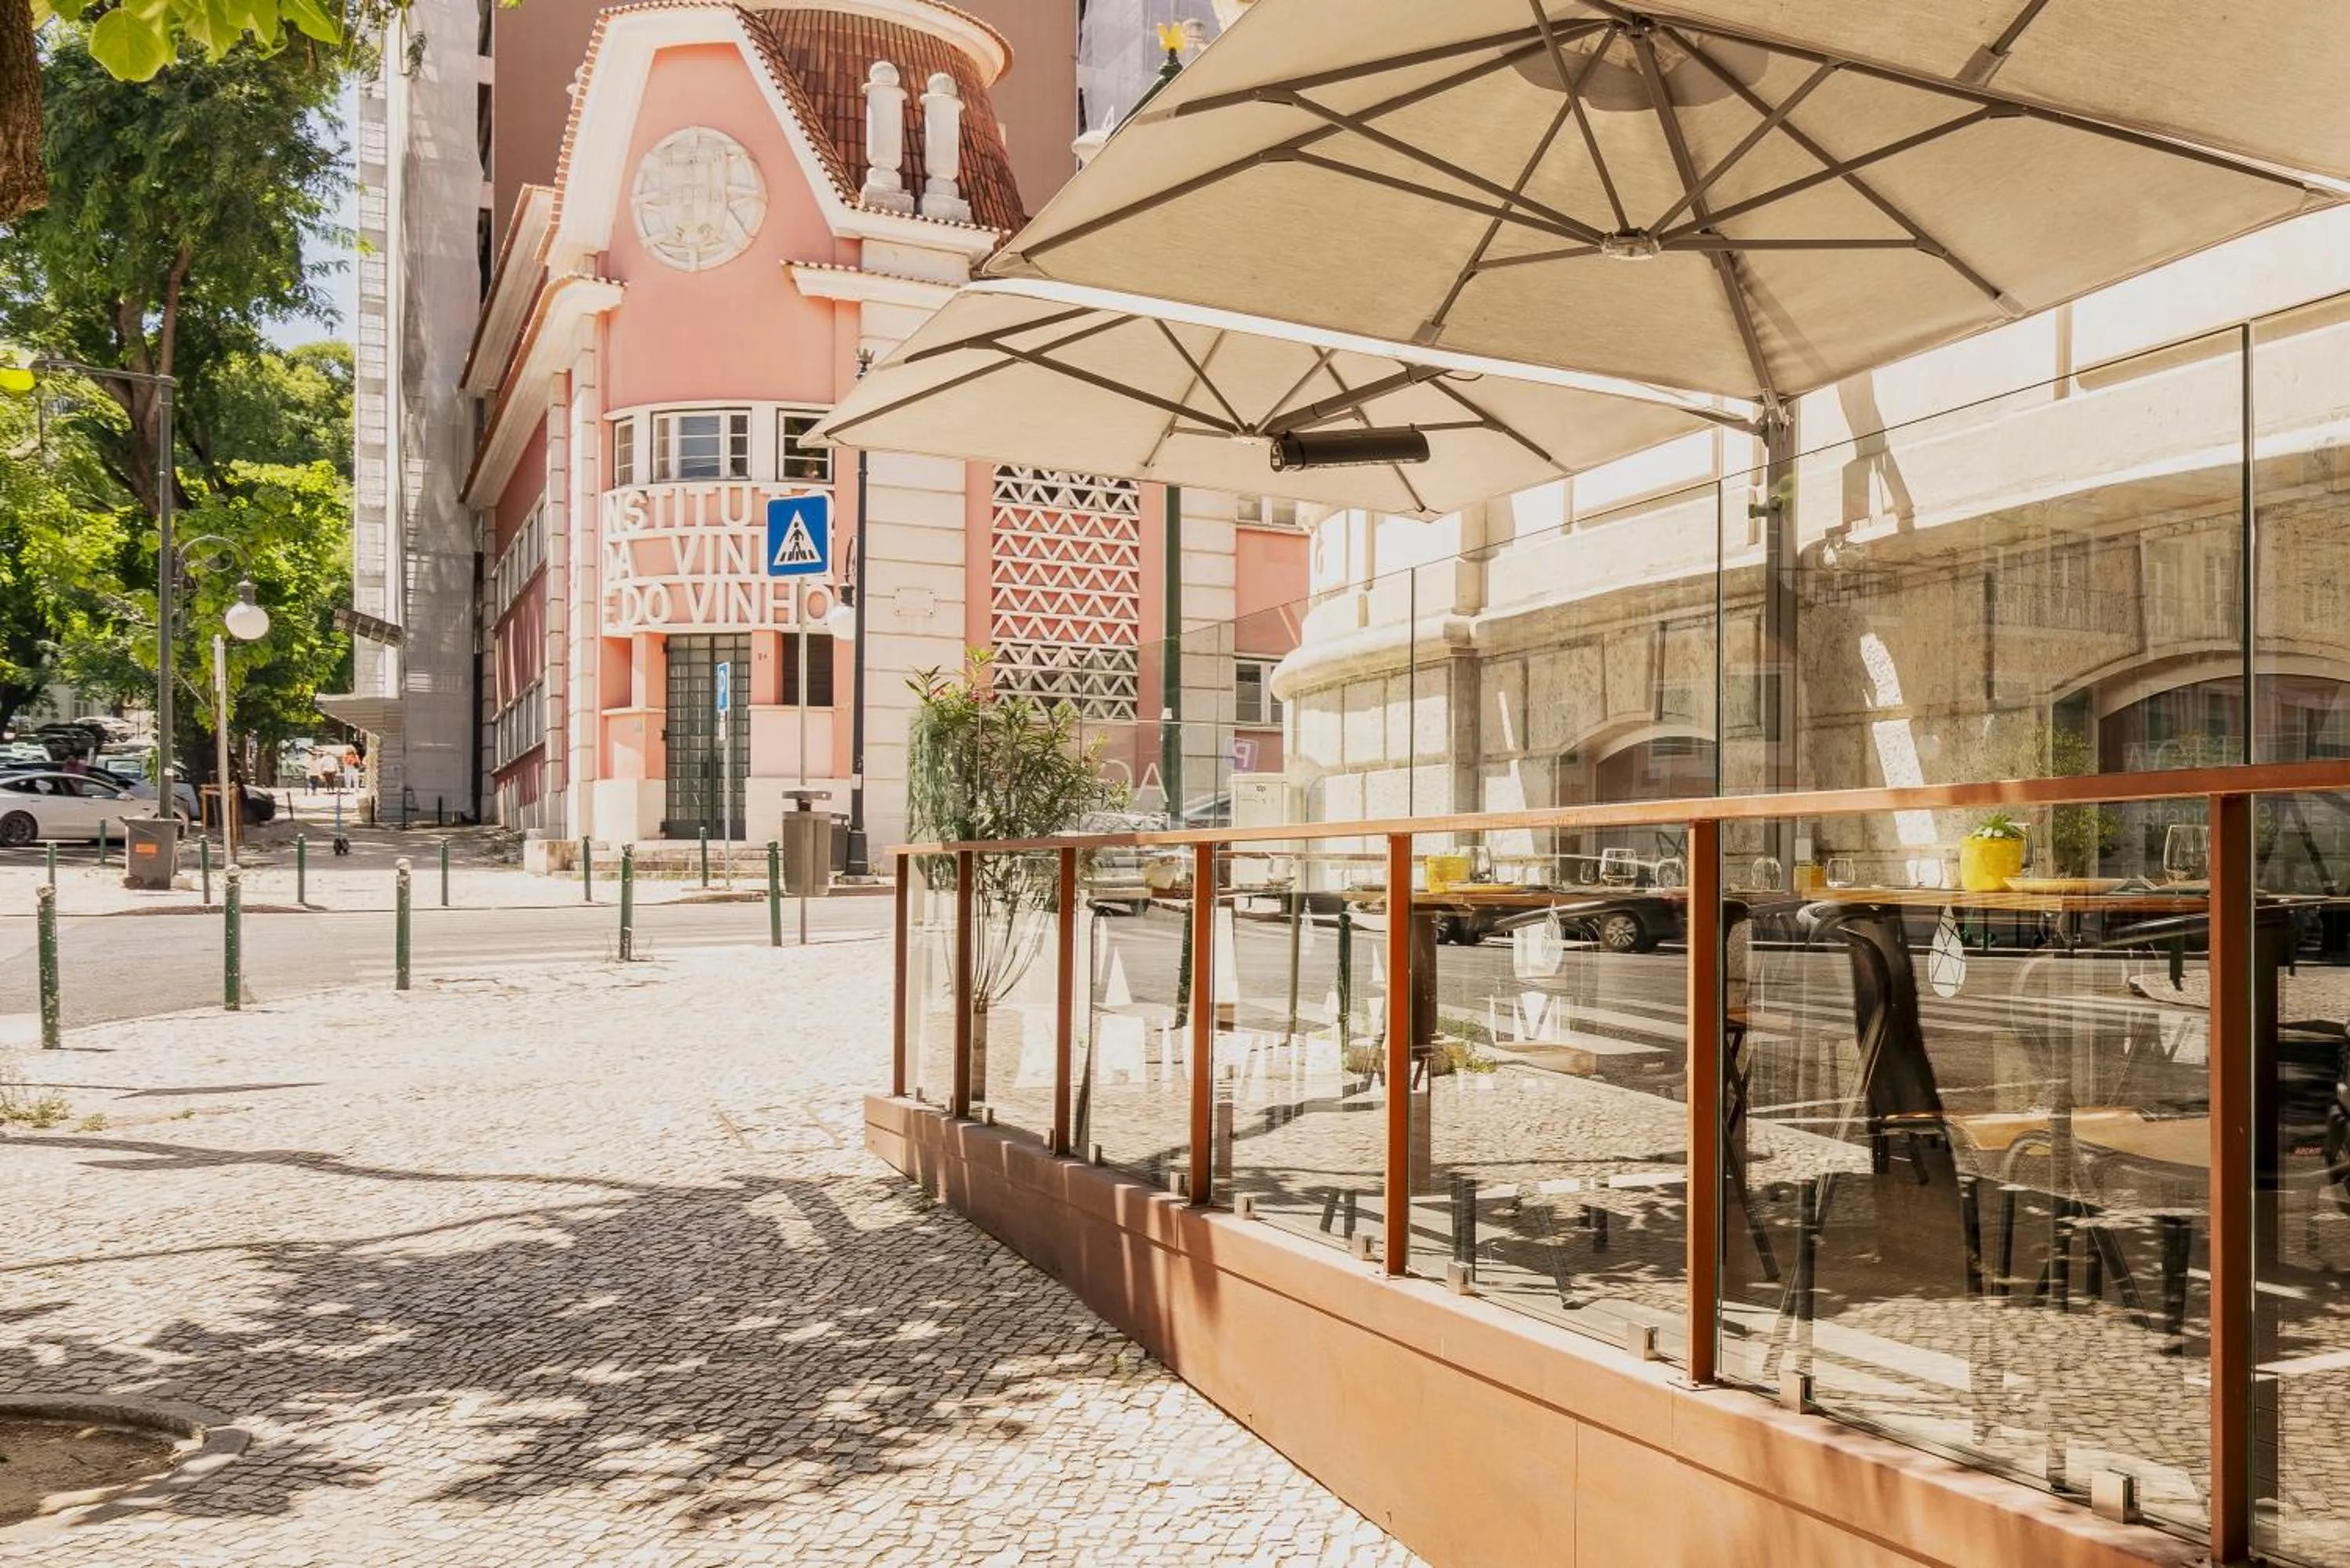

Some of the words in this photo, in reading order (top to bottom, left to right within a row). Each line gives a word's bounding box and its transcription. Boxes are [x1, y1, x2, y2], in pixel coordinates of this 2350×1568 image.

[671, 532, 832, 580] VIN
[622, 582, 671, 627] DO
[685, 580, 832, 625] VINHO
